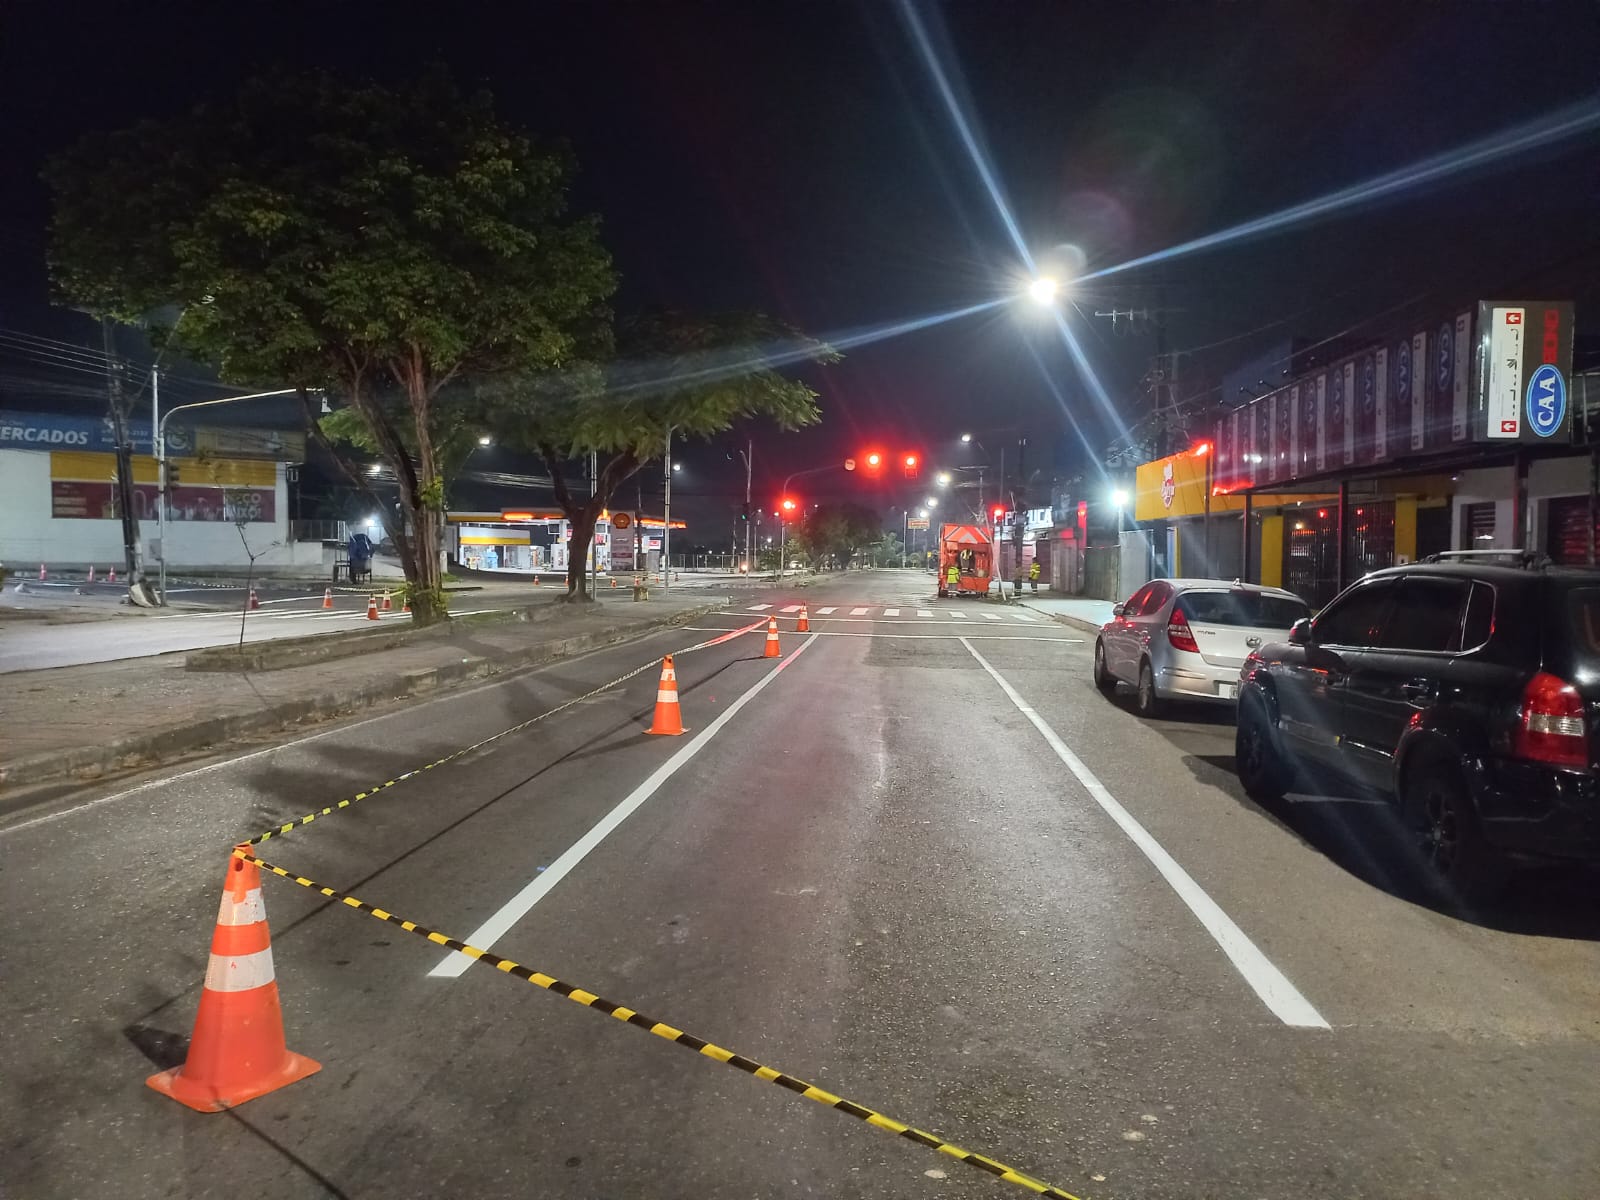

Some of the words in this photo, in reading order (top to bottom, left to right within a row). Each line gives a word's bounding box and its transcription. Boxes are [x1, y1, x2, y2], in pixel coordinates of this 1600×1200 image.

[1399, 351, 1407, 393] CAA
[1440, 333, 1449, 381] CAA
[1537, 374, 1556, 427] CAA
[0, 426, 89, 445] ERCADOS
